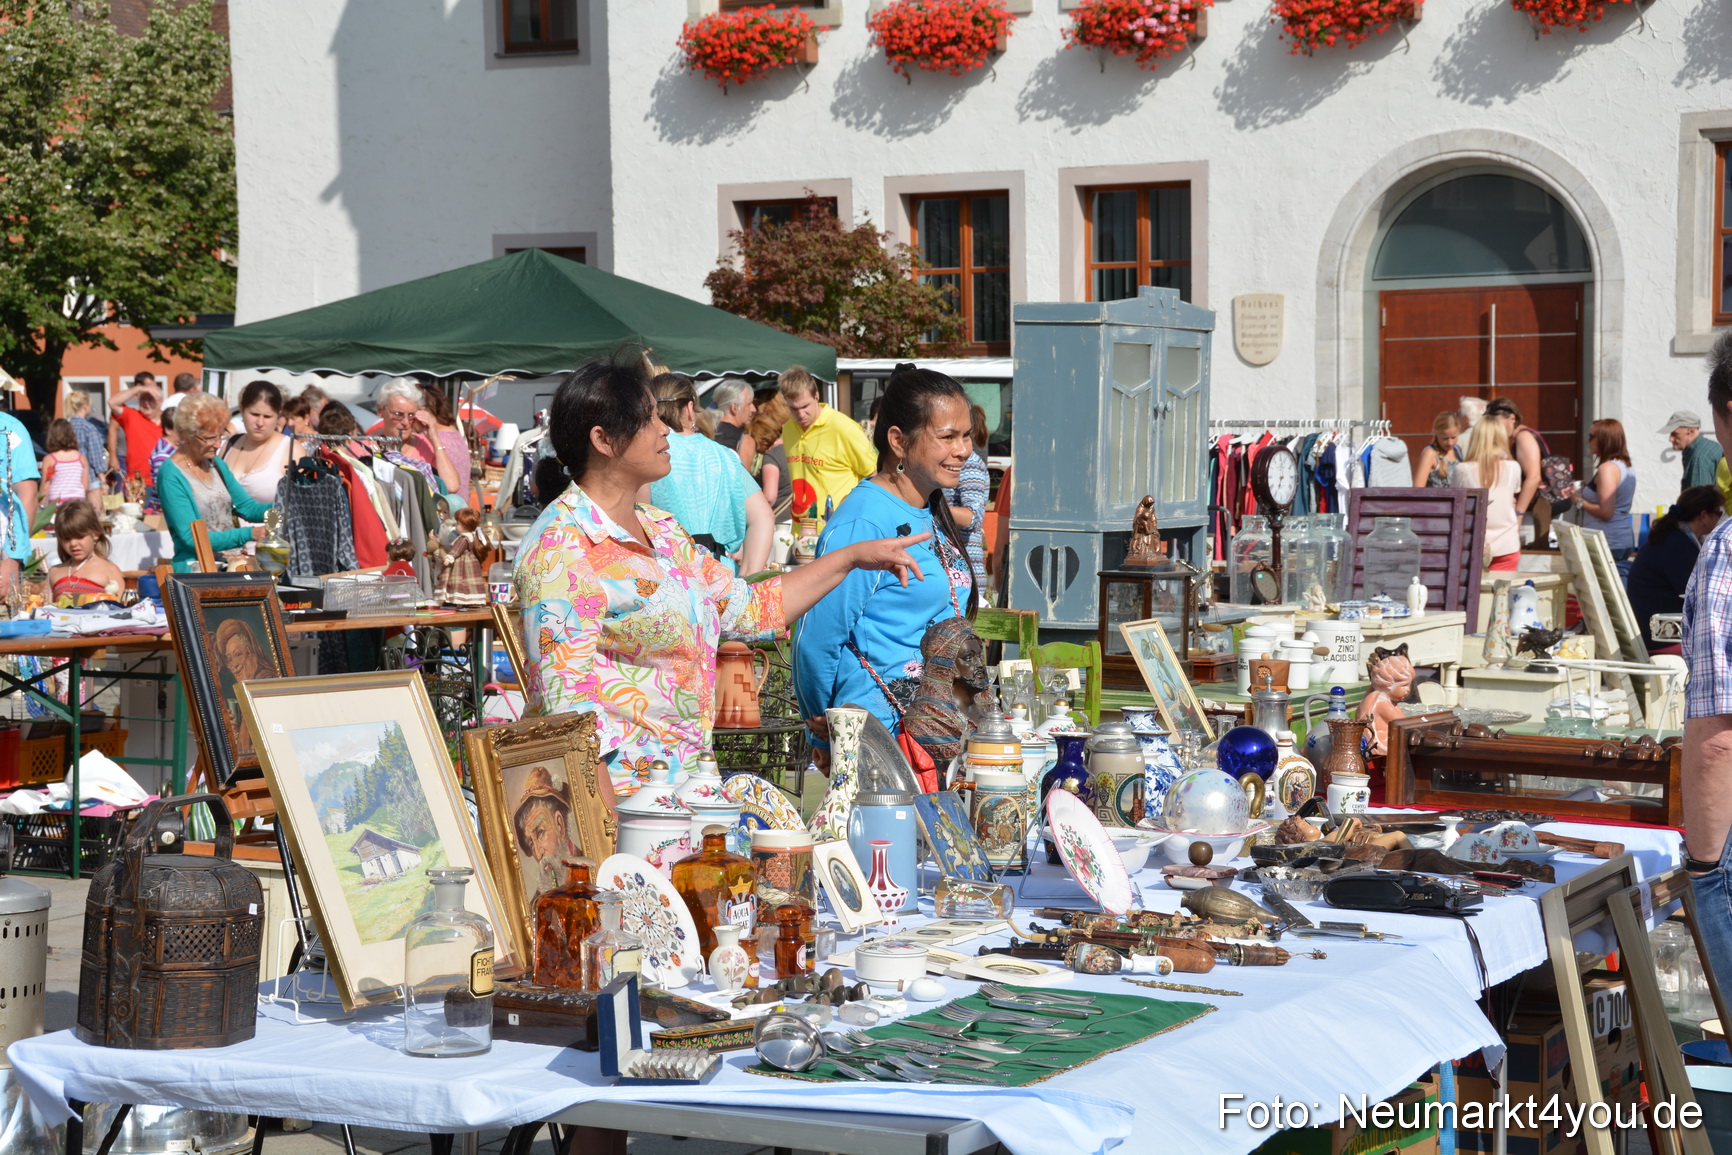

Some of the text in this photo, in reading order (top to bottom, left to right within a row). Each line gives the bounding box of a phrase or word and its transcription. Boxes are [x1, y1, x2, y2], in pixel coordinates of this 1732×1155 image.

[1335, 635, 1357, 644] PASTA
[1337, 644, 1355, 653] ZINCI
[733, 907, 749, 920] AQUA
[1596, 989, 1630, 1035] C 700
